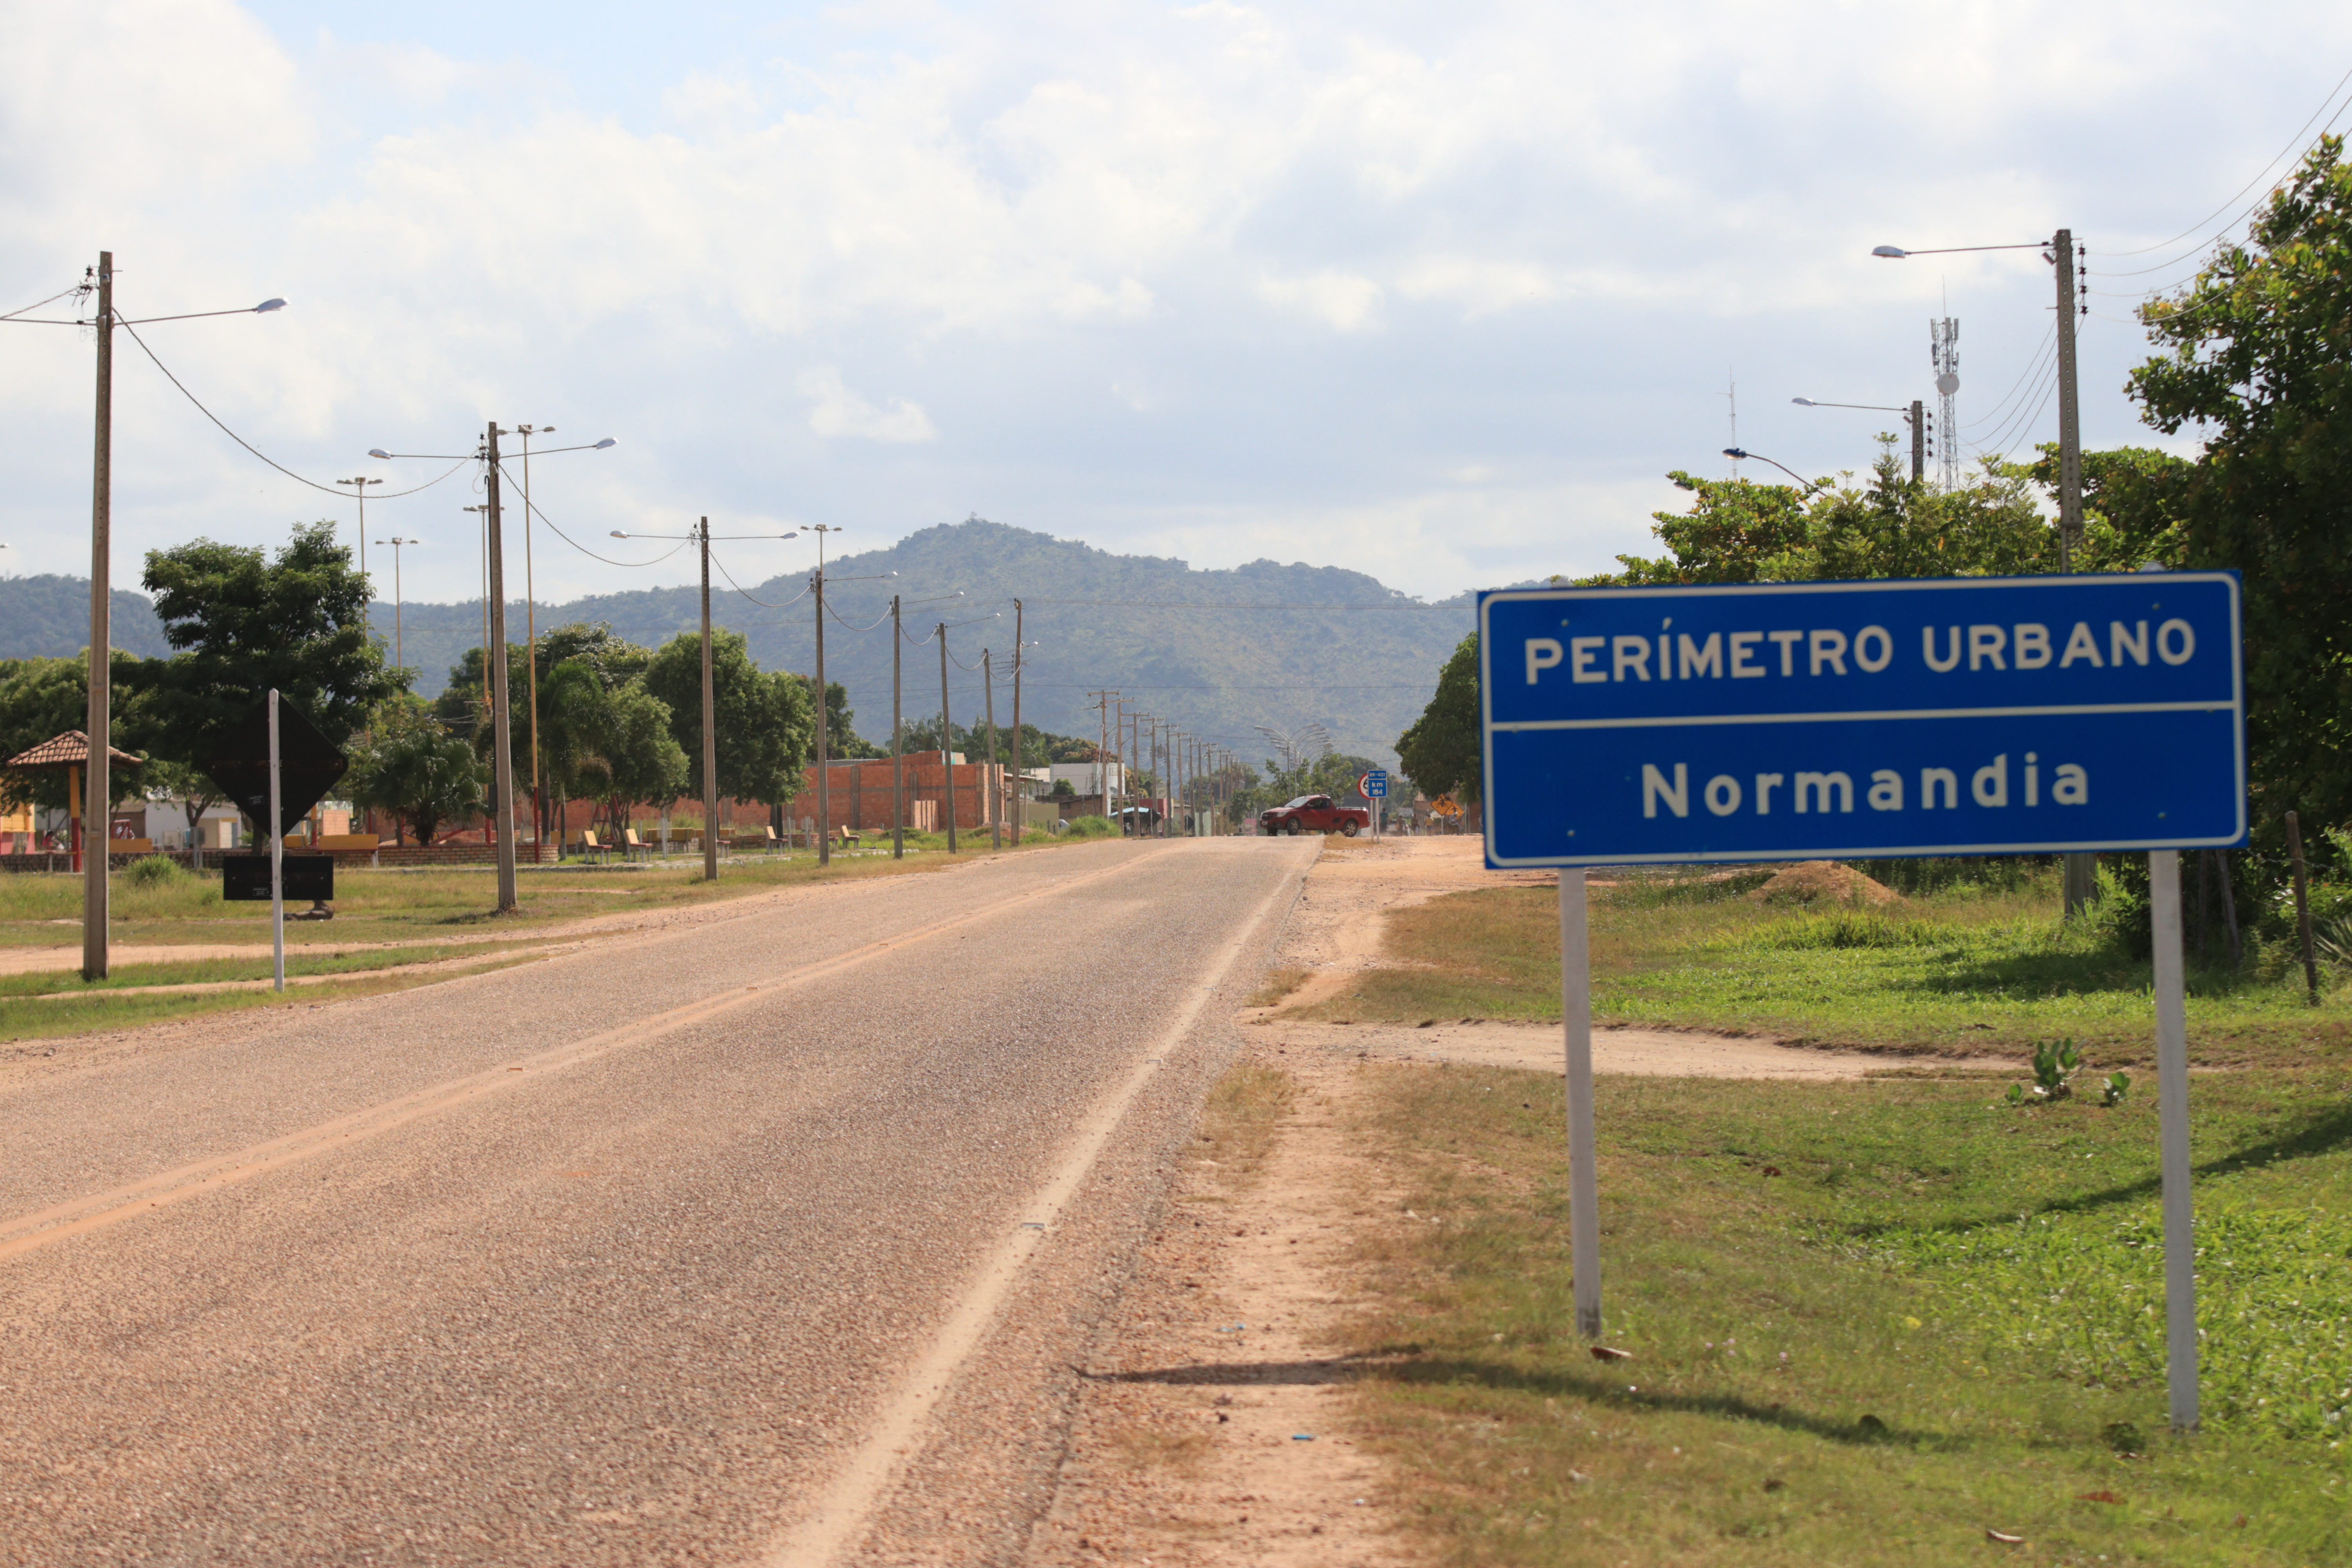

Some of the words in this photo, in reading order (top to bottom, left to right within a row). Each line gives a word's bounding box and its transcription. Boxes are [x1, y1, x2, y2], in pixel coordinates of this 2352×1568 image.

[1525, 617, 1893, 685] PERÍMETRO
[1922, 618, 2195, 673] URBANO
[1642, 753, 2089, 818] Normandia
